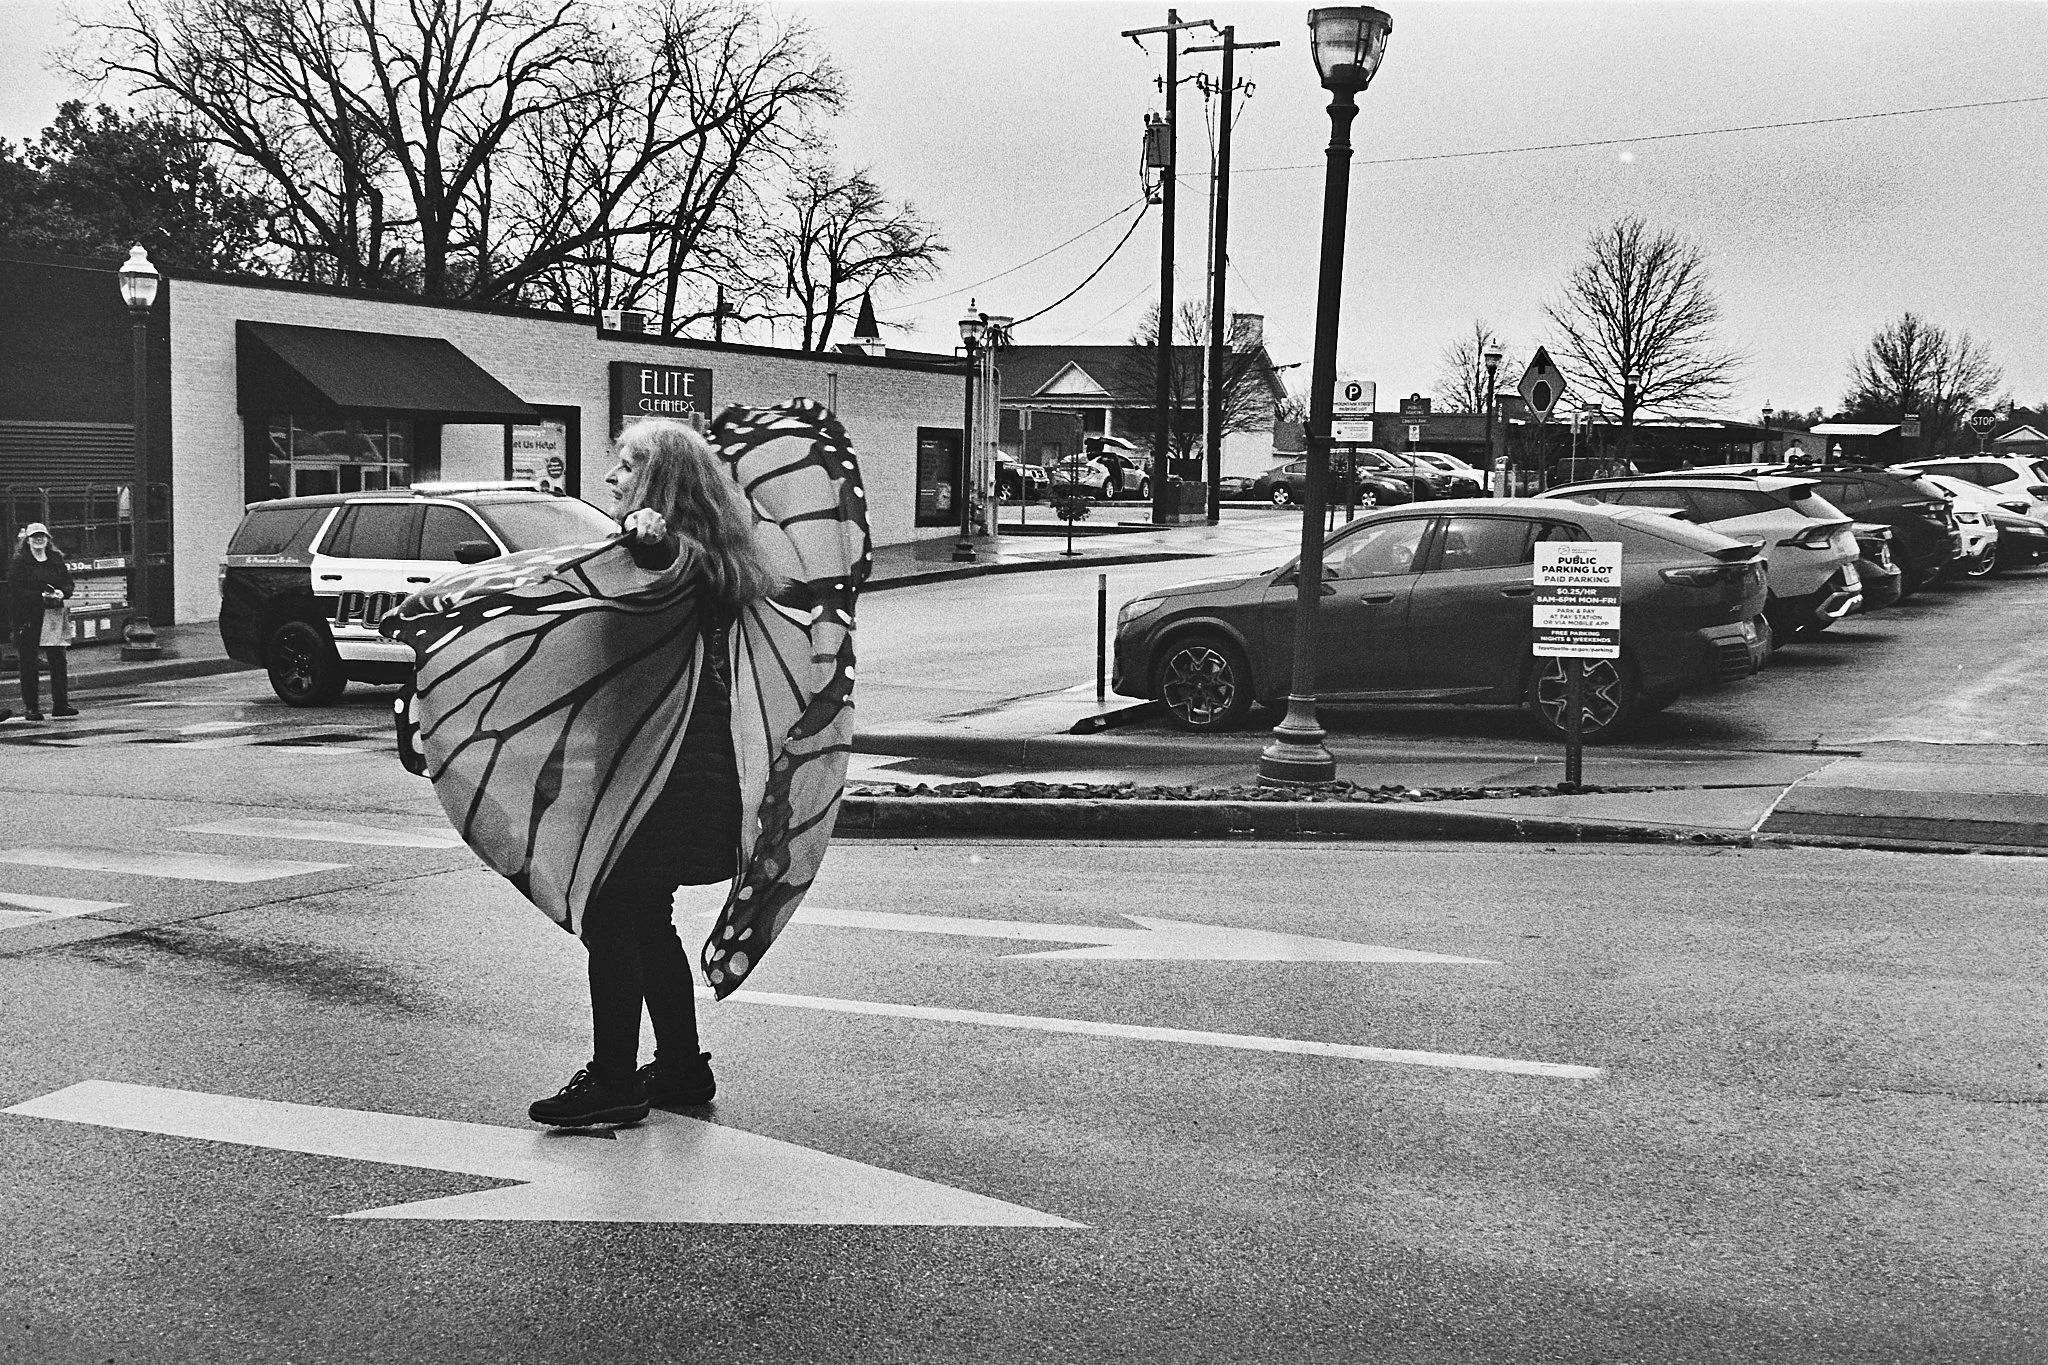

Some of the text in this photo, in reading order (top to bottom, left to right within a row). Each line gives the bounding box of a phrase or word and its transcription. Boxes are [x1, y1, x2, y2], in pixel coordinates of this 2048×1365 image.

[640, 369, 695, 397] ELITE
[638, 398, 695, 413] CLEANERS
[1972, 416, 1995, 426] STOP
[1558, 557, 1597, 565] PUBLIC
[1541, 565, 1613, 574] PARKING LOT
